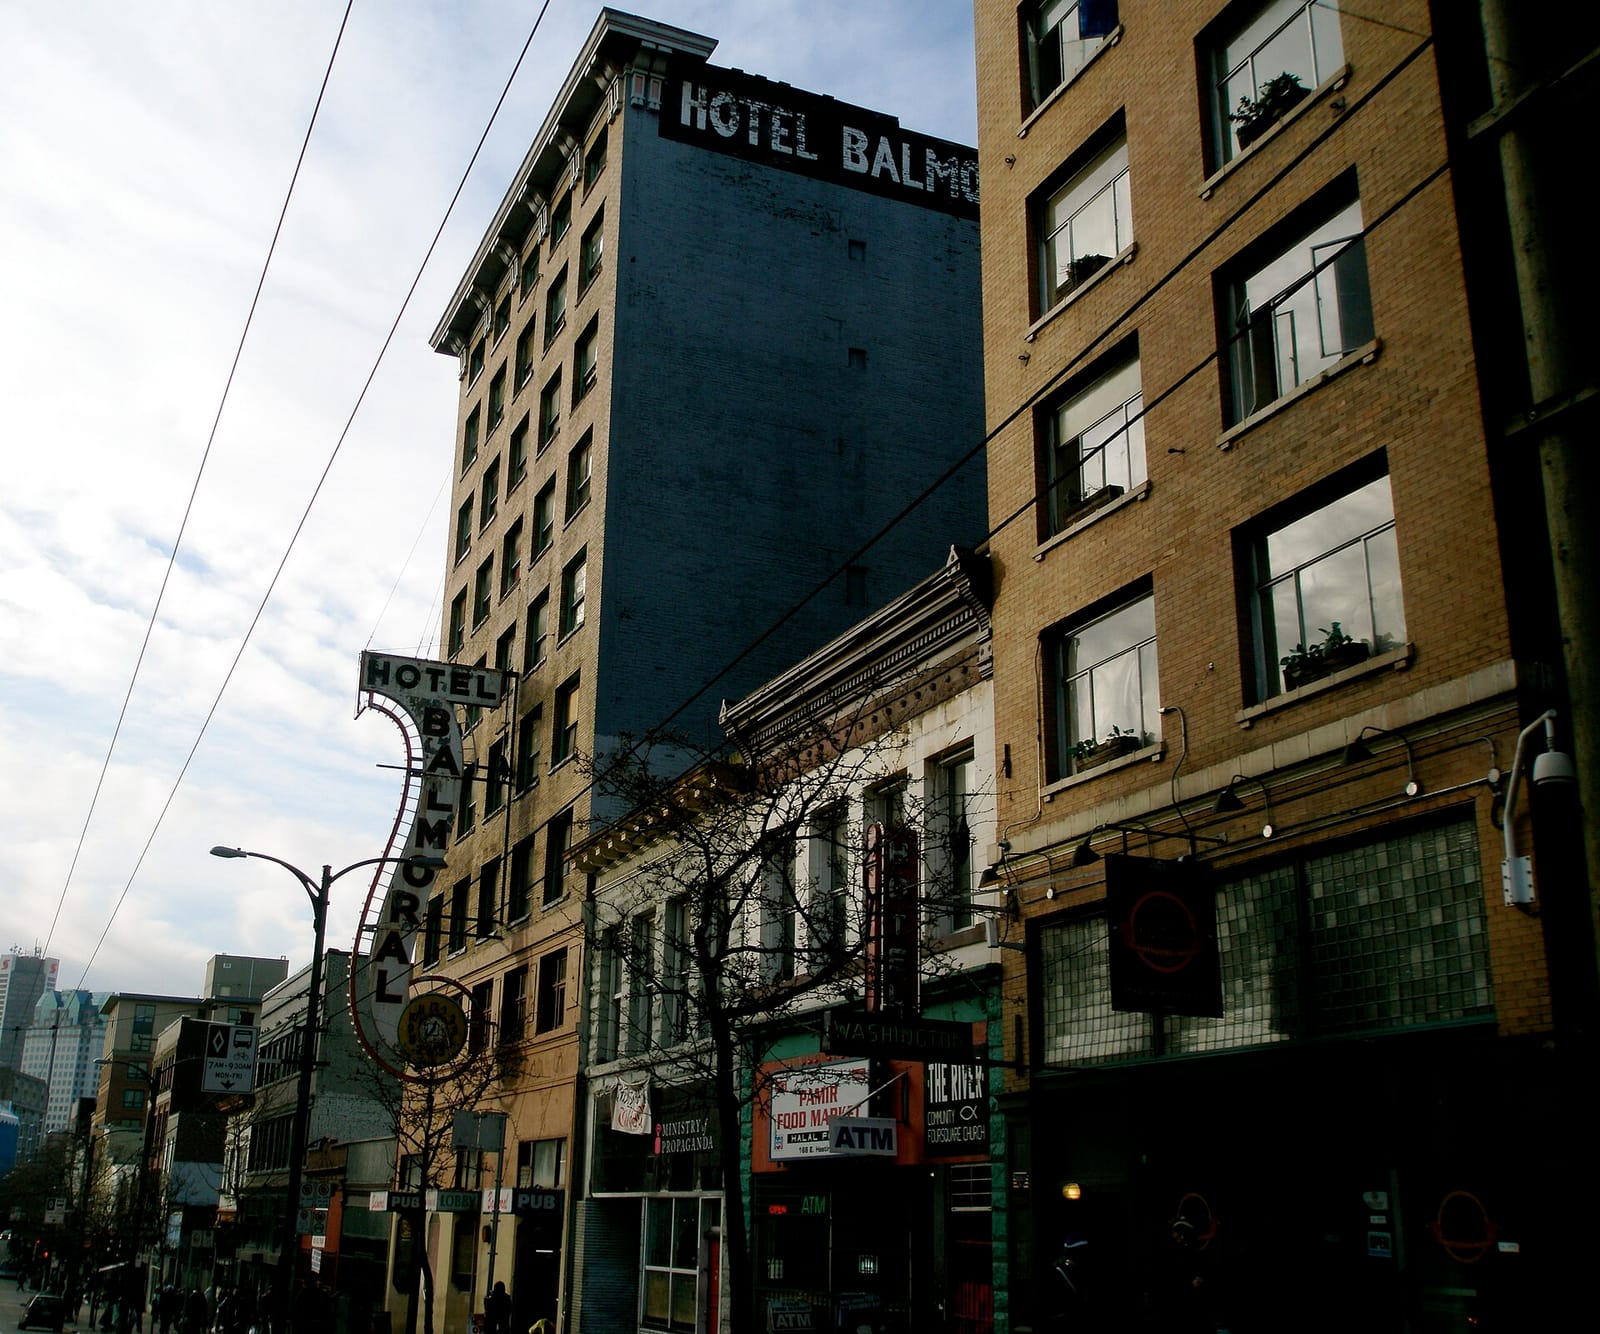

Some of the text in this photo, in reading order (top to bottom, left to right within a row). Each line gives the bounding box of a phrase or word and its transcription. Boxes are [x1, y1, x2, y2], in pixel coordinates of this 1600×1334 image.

[680, 80, 818, 161] HOTEL
[367, 659, 497, 700] HOTEL
[374, 706, 461, 1004] BALMORAL
[928, 1063, 984, 1104] THE RIVER
[799, 1085, 839, 1107] PAMIR
[662, 1119, 701, 1137] MINISTRY
[777, 1111, 807, 1131] FOOD
[791, 1132, 818, 1143] HALAL
[834, 1125, 894, 1151] ATM
[963, 1124, 986, 1142] CHURCH
[661, 1135, 714, 1154] PROPAGANDA
[391, 1194, 420, 1209] PUB
[440, 1194, 476, 1208] LOBBY
[517, 1194, 555, 1210] PUB
[801, 1195, 826, 1216] ATM
[775, 1313, 812, 1329] ATM
